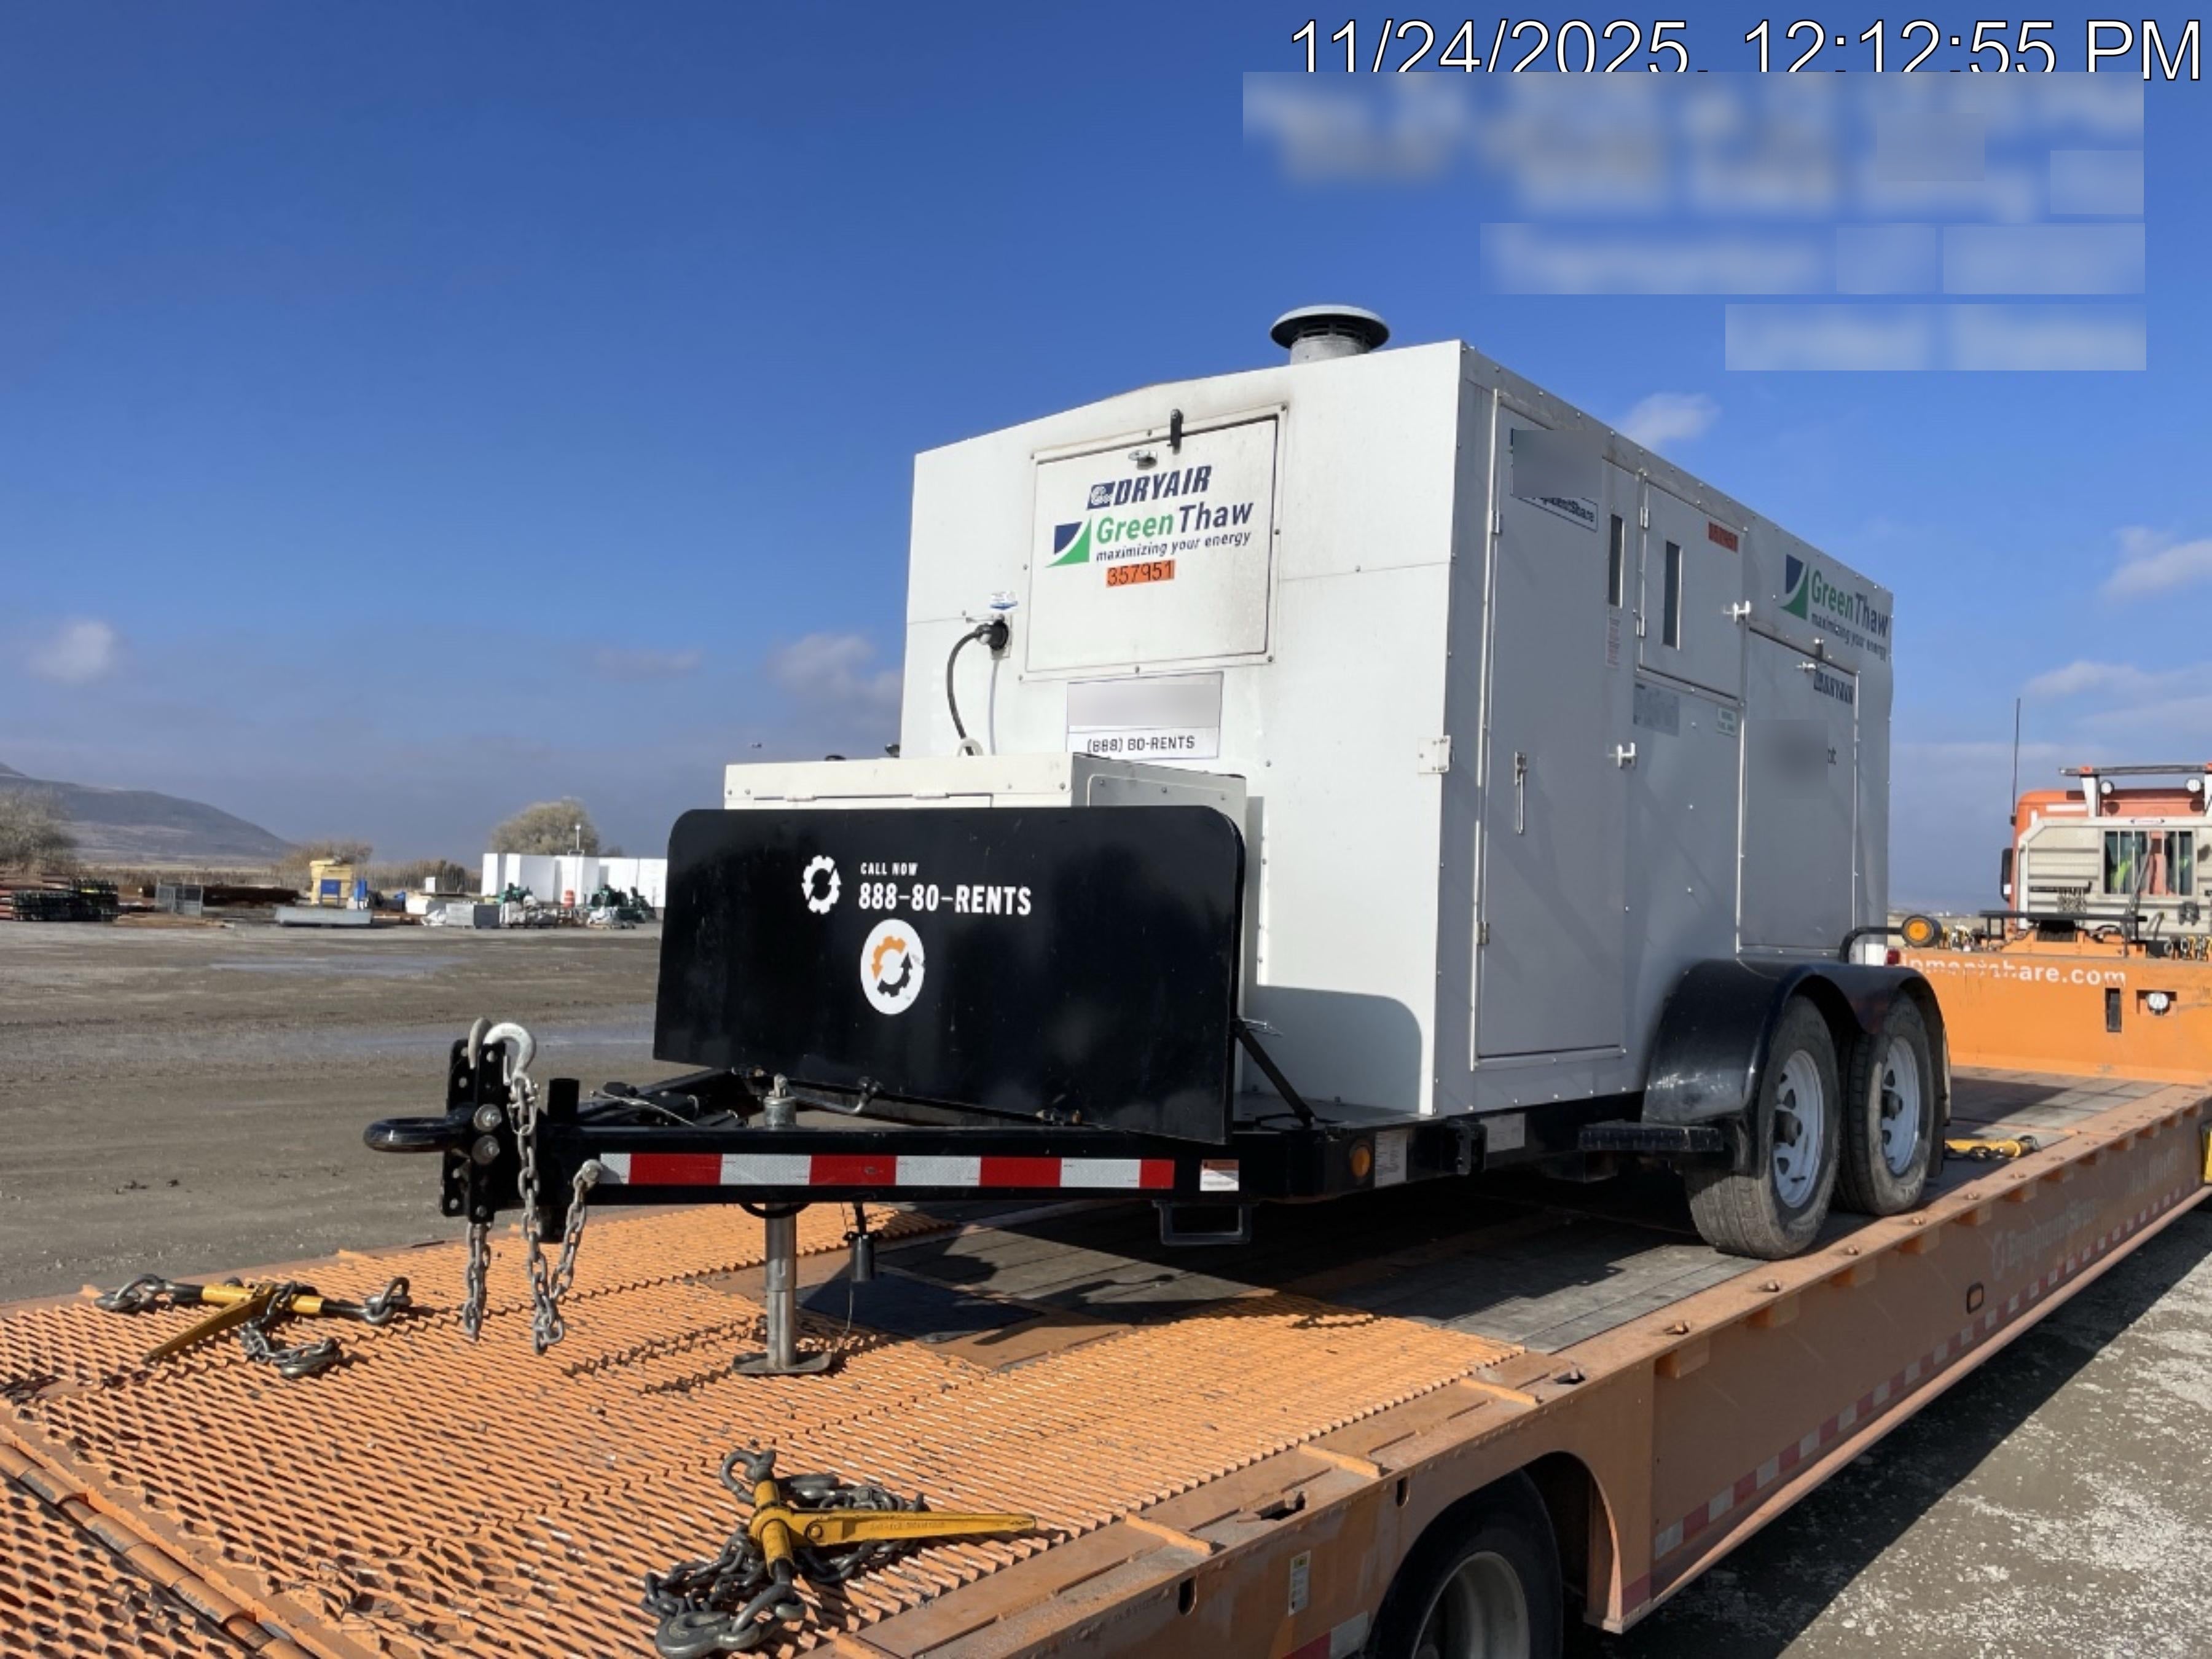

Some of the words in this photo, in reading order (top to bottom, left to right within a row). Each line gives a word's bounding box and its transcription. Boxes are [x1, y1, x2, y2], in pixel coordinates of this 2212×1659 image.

[1113, 465, 1212, 506] DRYAIR
[1096, 541, 1167, 562] maximizing
[1171, 538, 1201, 554] your
[1204, 531, 1252, 547] energy
[1107, 560, 1174, 586] 357951
[860, 862, 888, 876] CALL
[892, 862, 919, 876] NOW
[858, 882, 1032, 916] 888-80-RENTS
